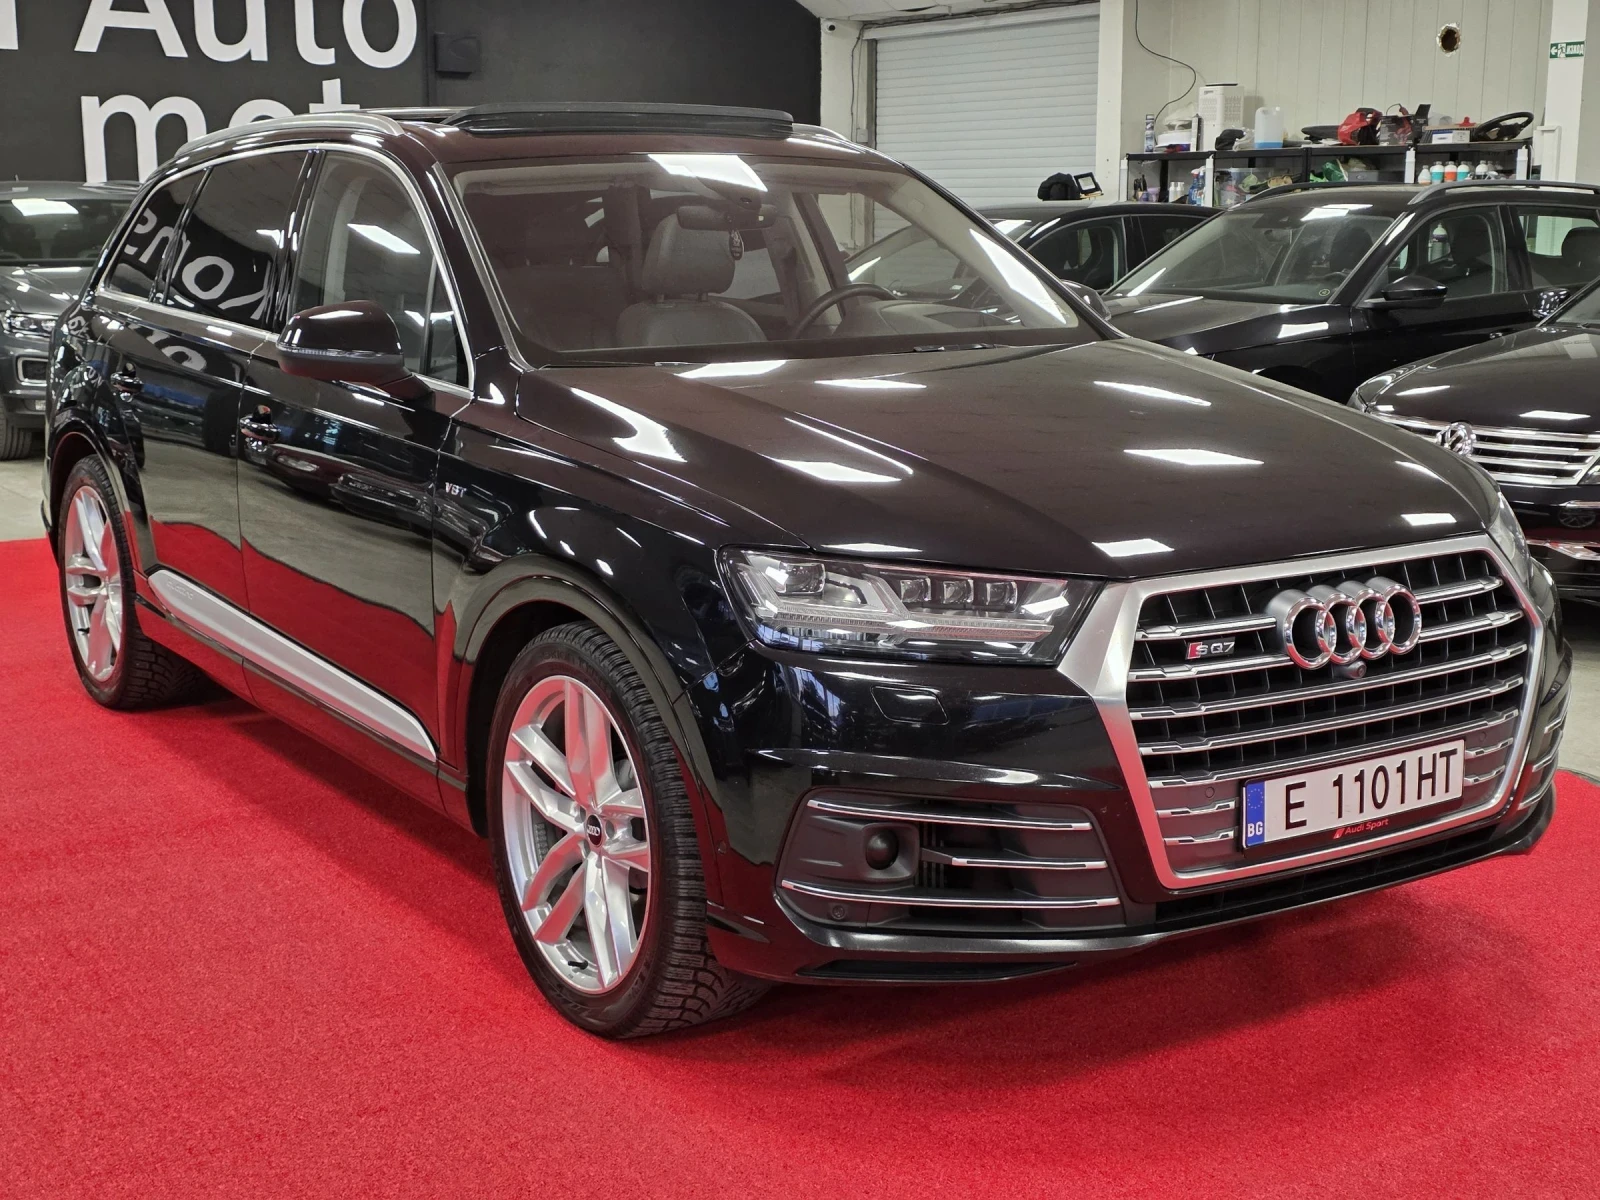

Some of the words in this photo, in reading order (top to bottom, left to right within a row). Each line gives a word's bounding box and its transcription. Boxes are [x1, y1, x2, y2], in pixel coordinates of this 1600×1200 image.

[445, 481, 467, 498] V8T
[1285, 781, 1307, 830] E
[1247, 821, 1263, 837] BG
[1344, 818, 1366, 835] Audi
[1366, 818, 1390, 831] Sport
